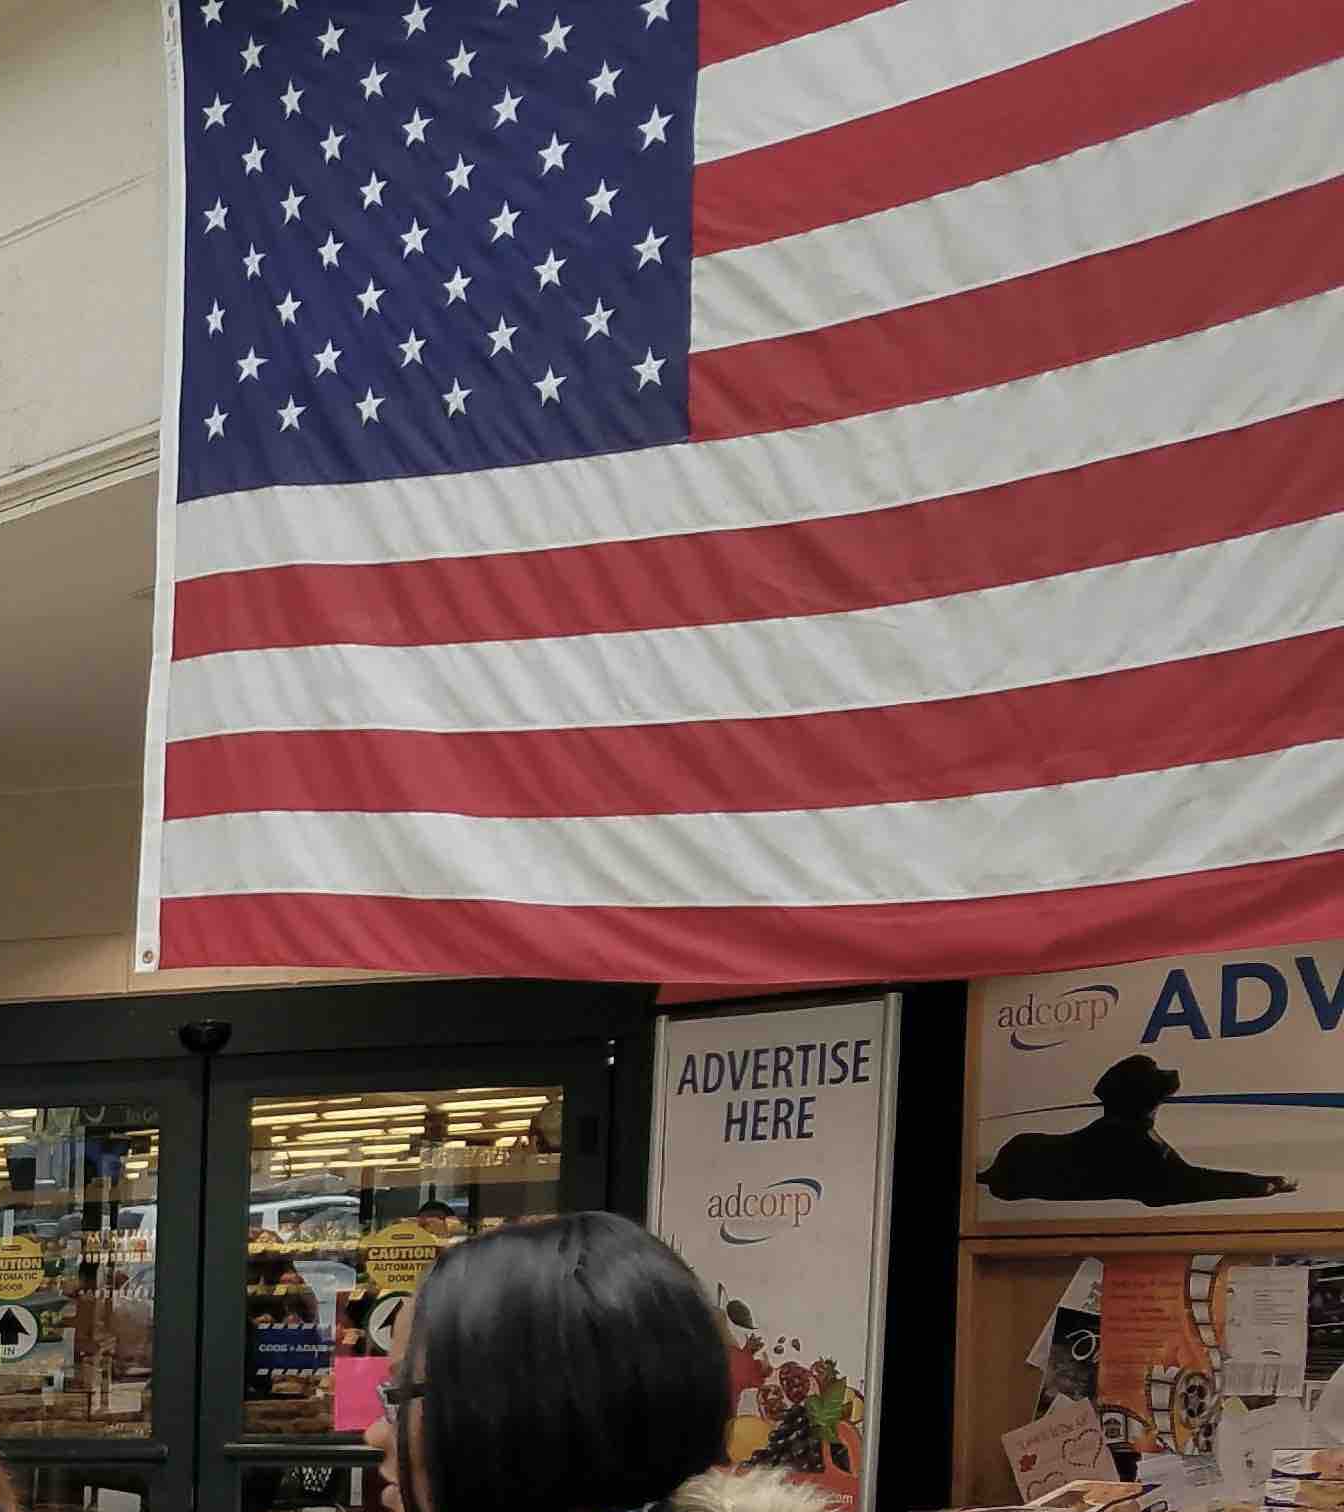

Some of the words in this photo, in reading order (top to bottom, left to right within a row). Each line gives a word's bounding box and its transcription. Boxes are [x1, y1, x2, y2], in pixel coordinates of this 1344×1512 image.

[997, 992, 1110, 1030] adcorp
[677, 1039, 872, 1095] ADVERTISE
[724, 1096, 817, 1143] HERE
[707, 1183, 812, 1227] adcorp
[368, 1247, 436, 1260] CAUTION
[373, 1264, 426, 1272] AUTOMATI
[387, 1274, 416, 1282] DOOR
